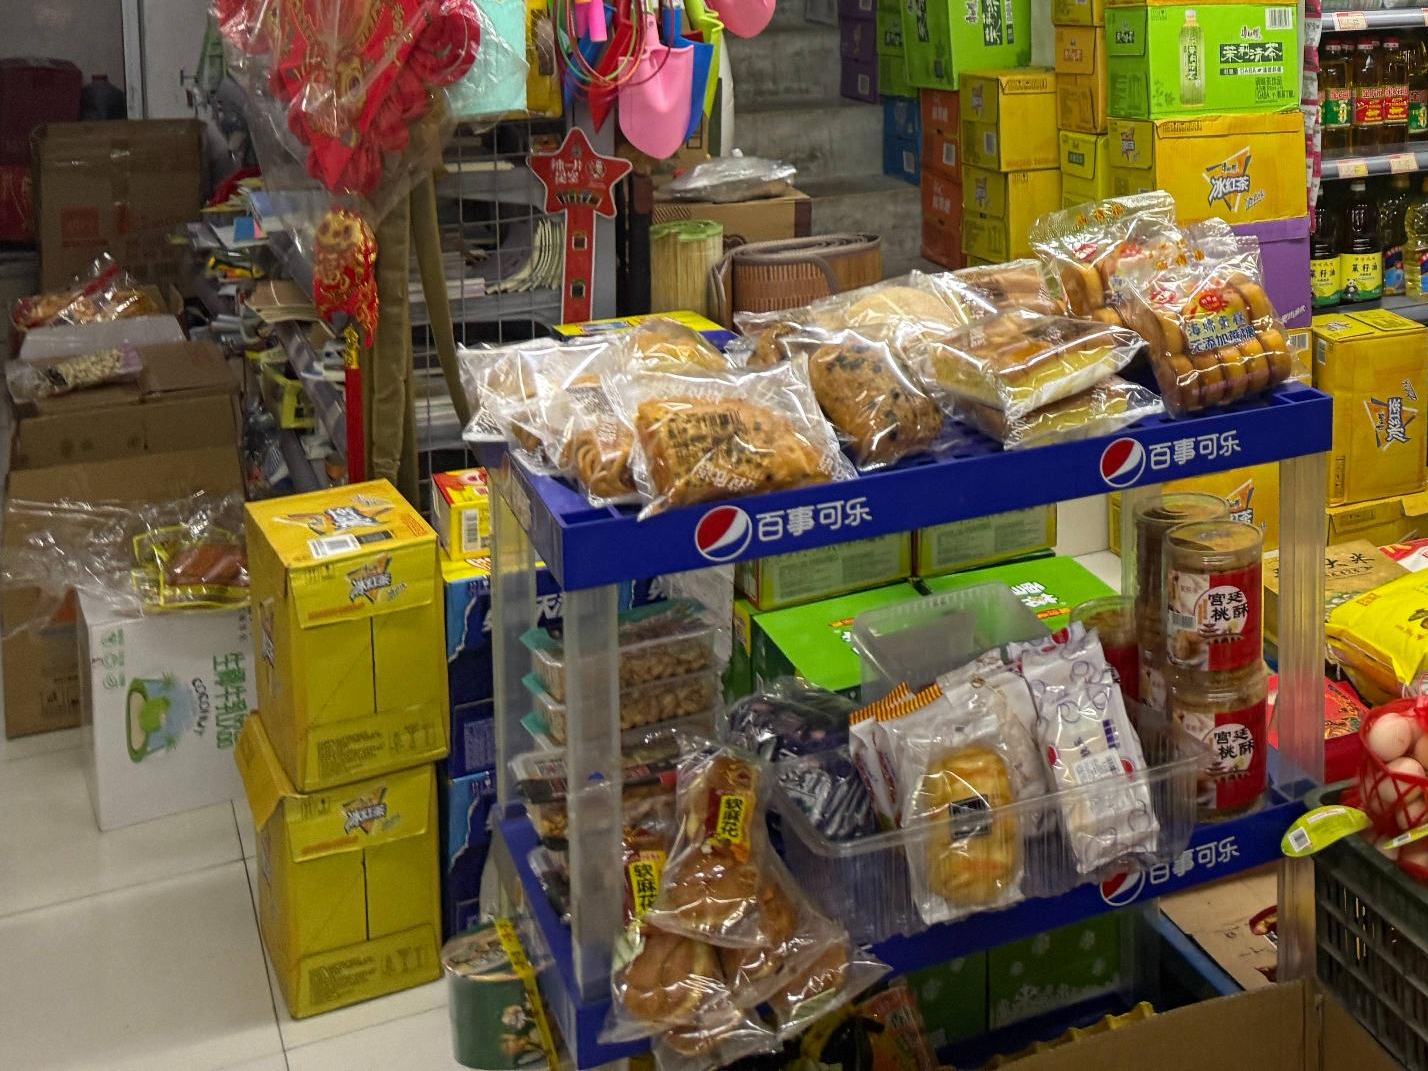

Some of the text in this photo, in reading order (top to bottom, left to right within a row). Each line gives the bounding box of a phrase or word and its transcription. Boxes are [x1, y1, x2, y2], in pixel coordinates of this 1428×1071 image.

[1150, 431, 1241, 468] 百事可乐
[756, 497, 873, 534] 百事可乐
[1208, 591, 1243, 607] 宫廷
[1211, 604, 1249, 623] 桃酥
[1218, 740, 1254, 761] 桃酥
